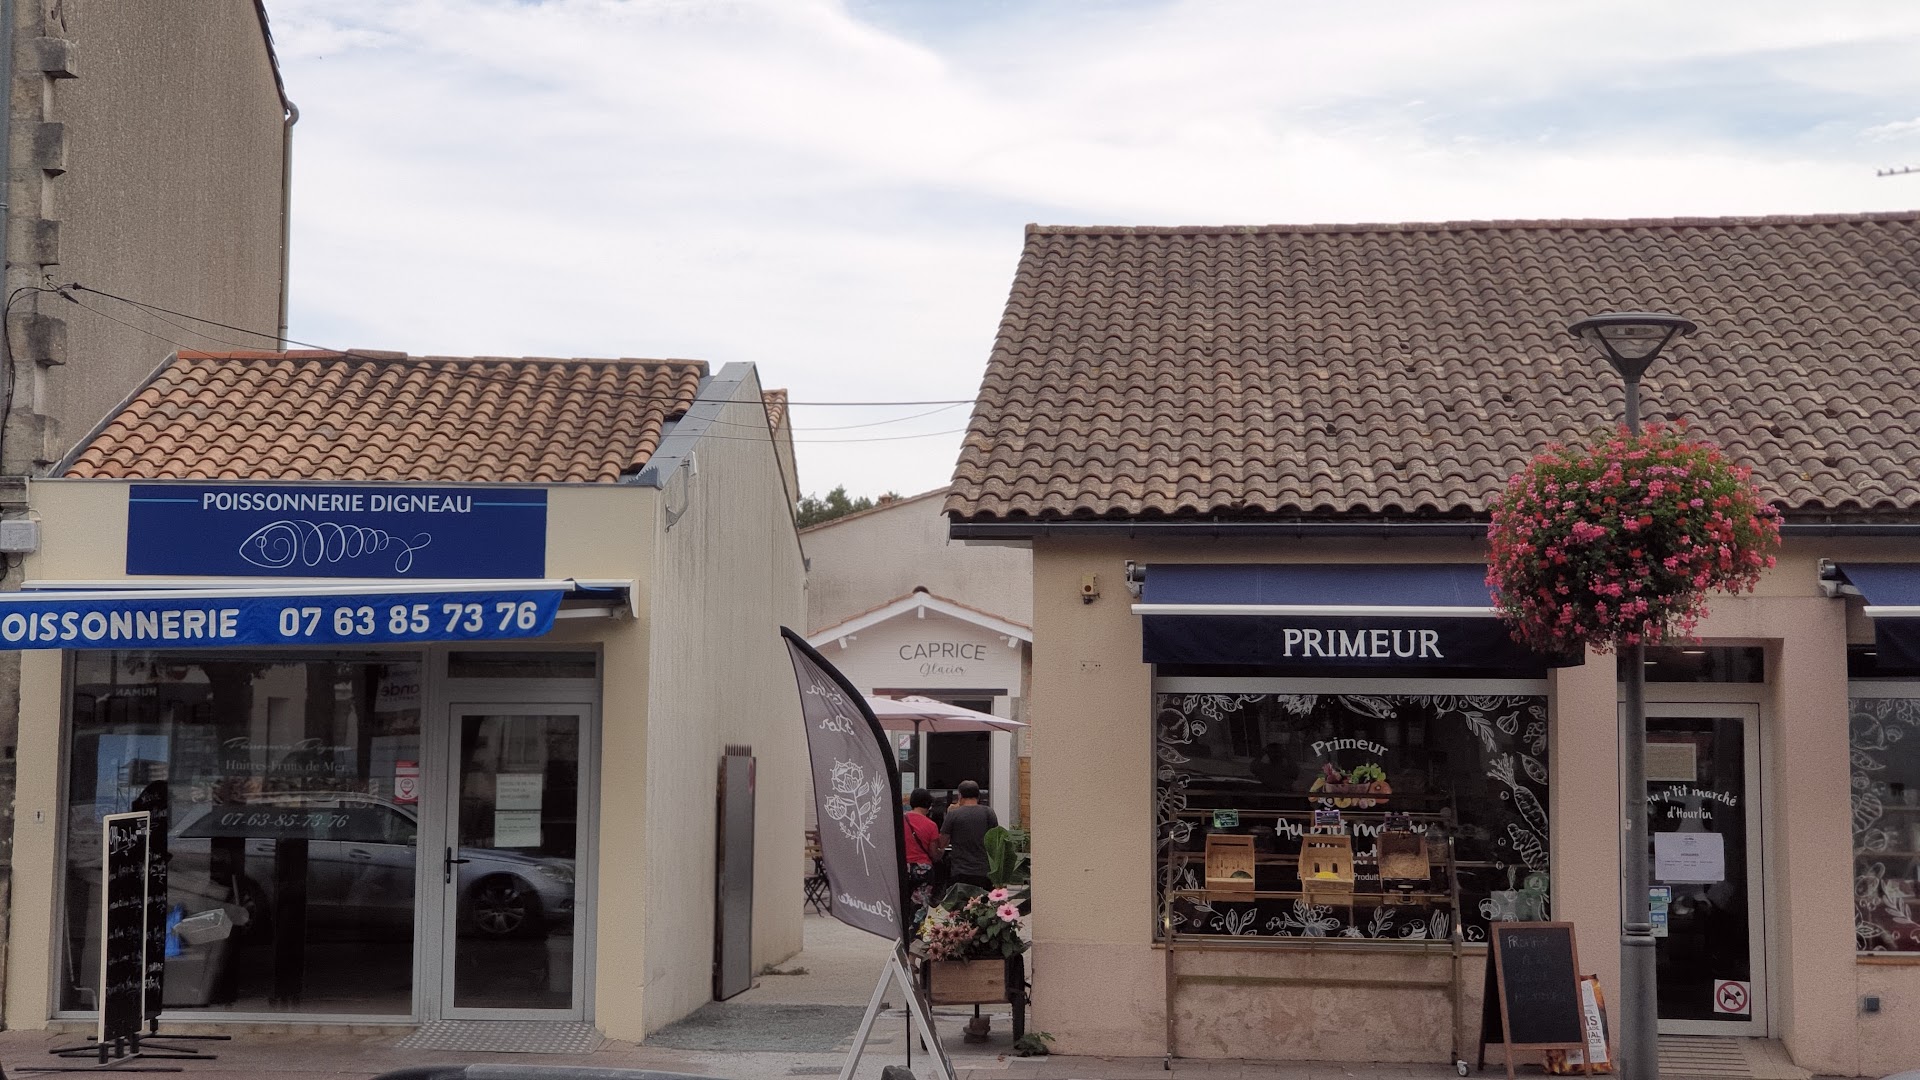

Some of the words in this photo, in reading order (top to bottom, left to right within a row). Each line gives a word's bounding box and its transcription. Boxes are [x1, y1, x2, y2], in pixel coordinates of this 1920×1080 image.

[202, 492, 364, 513] POISSONNERIE
[370, 493, 472, 514] DIGNEAU
[0, 608, 239, 642] OISSONNERIE
[278, 606, 322, 636] 07
[333, 606, 376, 635] 63
[388, 604, 430, 634] 85
[442, 603, 483, 633] 73
[496, 601, 537, 630] 76
[899, 642, 987, 661] CAPRICE
[1282, 628, 1444, 659] PRIMEUR
[919, 662, 967, 677] Glacier
[1310, 736, 1389, 758] Primeur
[305, 759, 320, 772] de
[1662, 784, 1688, 804] p'tit
[1692, 788, 1738, 807] marché
[220, 812, 350, 829] 07-63-85-73-76
[1275, 817, 1304, 841] Au
